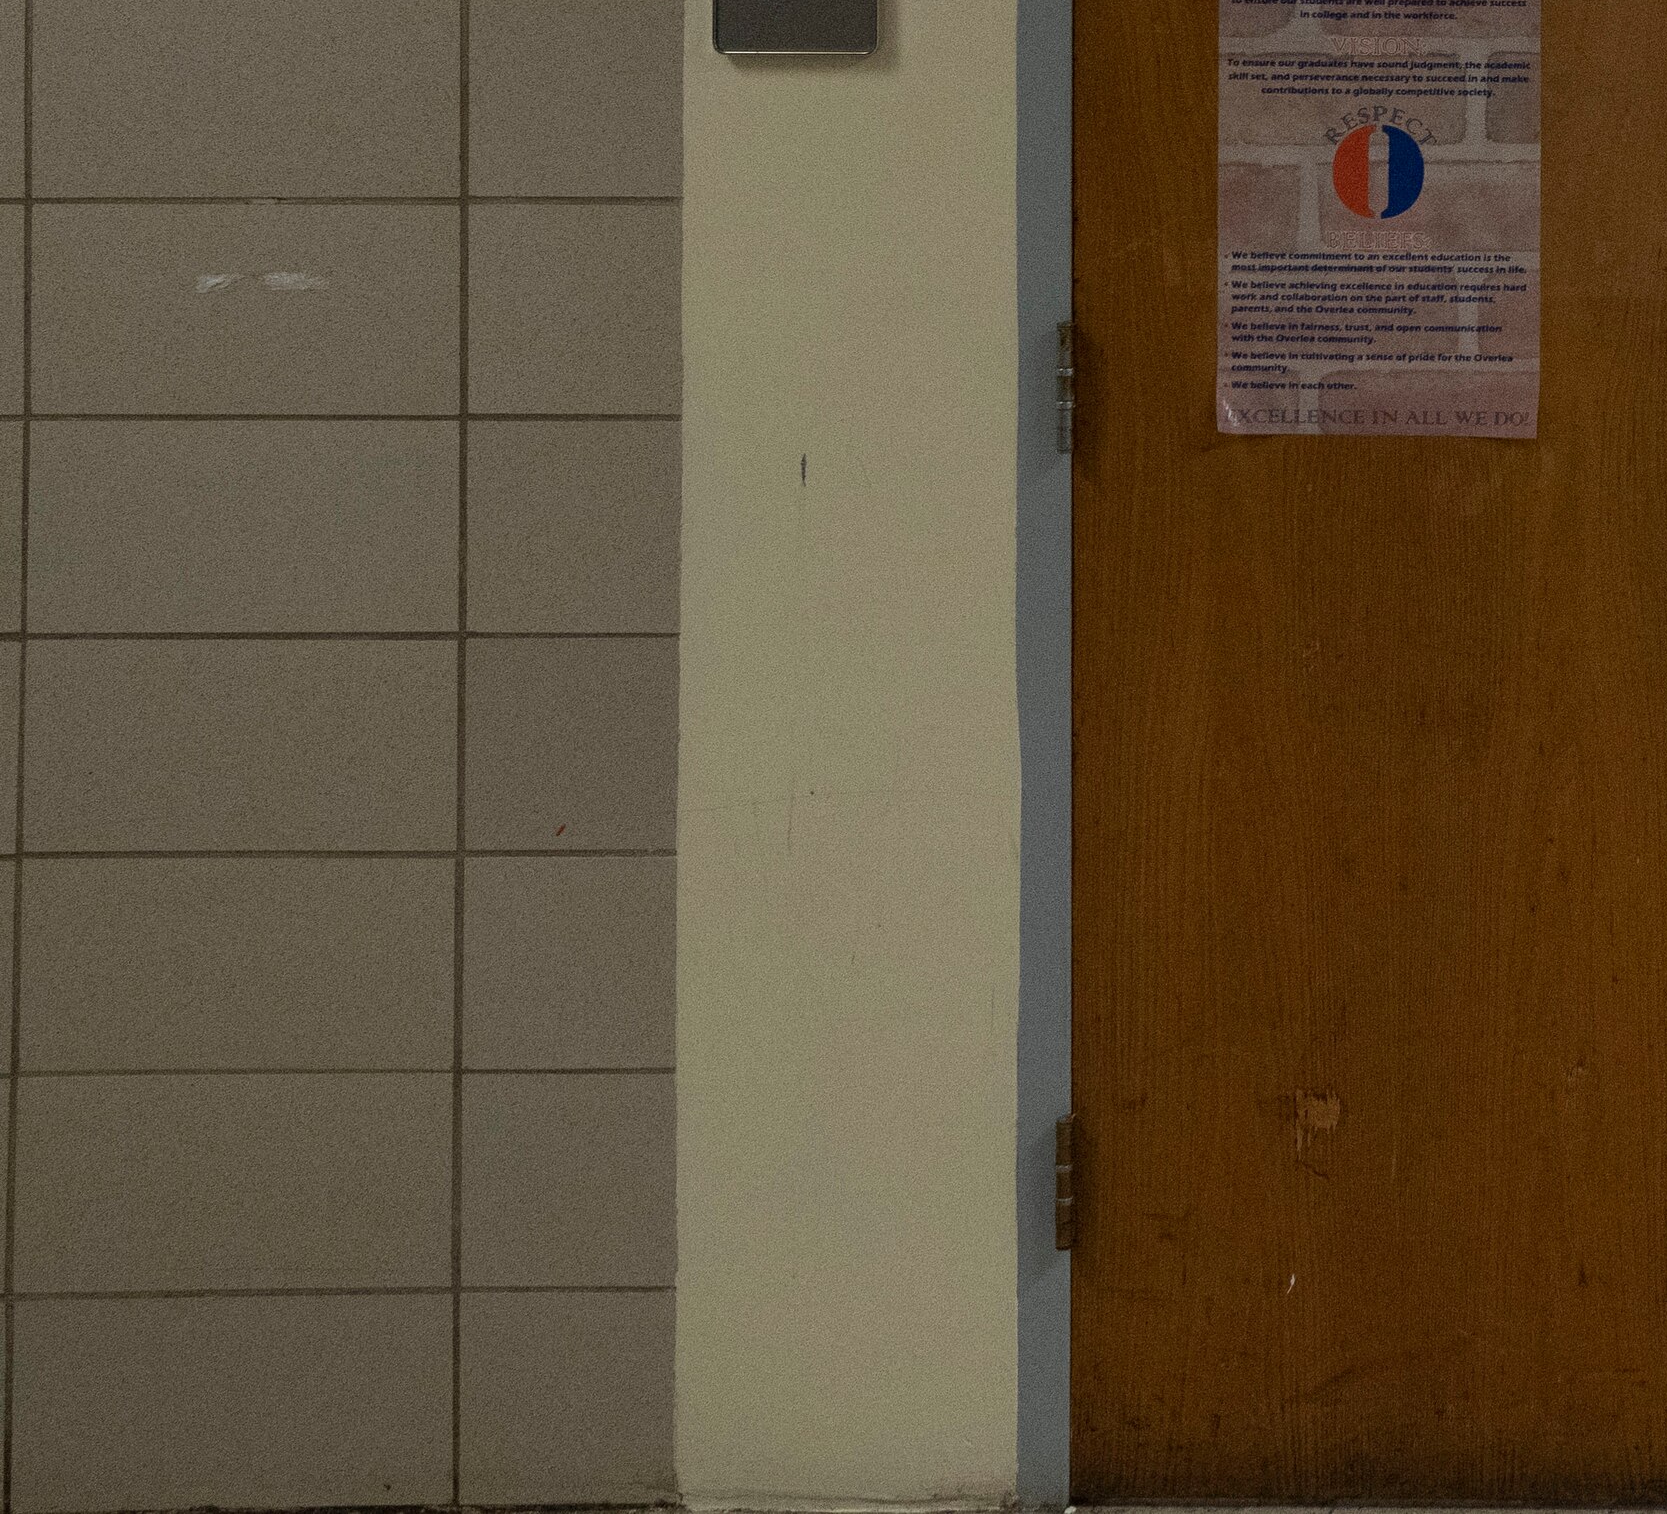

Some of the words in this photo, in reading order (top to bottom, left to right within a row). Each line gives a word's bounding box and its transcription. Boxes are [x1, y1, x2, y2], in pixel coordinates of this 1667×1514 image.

[1228, 58, 1240, 67] To
[1278, 60, 1295, 68] our
[1297, 59, 1348, 70] graduates
[1351, 59, 1374, 68] have
[1377, 60, 1408, 69] sound
[1465, 60, 1481, 69] the
[1485, 61, 1530, 70] academic
[1228, 72, 1249, 81] skill
[1251, 72, 1268, 81] set,
[1271, 72, 1290, 81] and
[1293, 74, 1359, 84] perseverance
[1361, 75, 1410, 84] necessary
[1412, 74, 1423, 83] to
[1426, 74, 1466, 83] succeed
[1468, 74, 1478, 83] in
[1480, 74, 1499, 83] and
[1502, 74, 1529, 83] make
[1261, 87, 1328, 96] contributions
[1331, 87, 1342, 96] to
[1353, 87, 1393, 98] globally
[1396, 88, 1455, 99] competitive
[1457, 88, 1495, 99] society.
[1324, 105, 1437, 148] RESPECT
[1372, 409, 1398, 425] IN
[1405, 410, 1449, 425] ALL
[1455, 411, 1488, 426] WE
[1494, 411, 1530, 427] DO!
